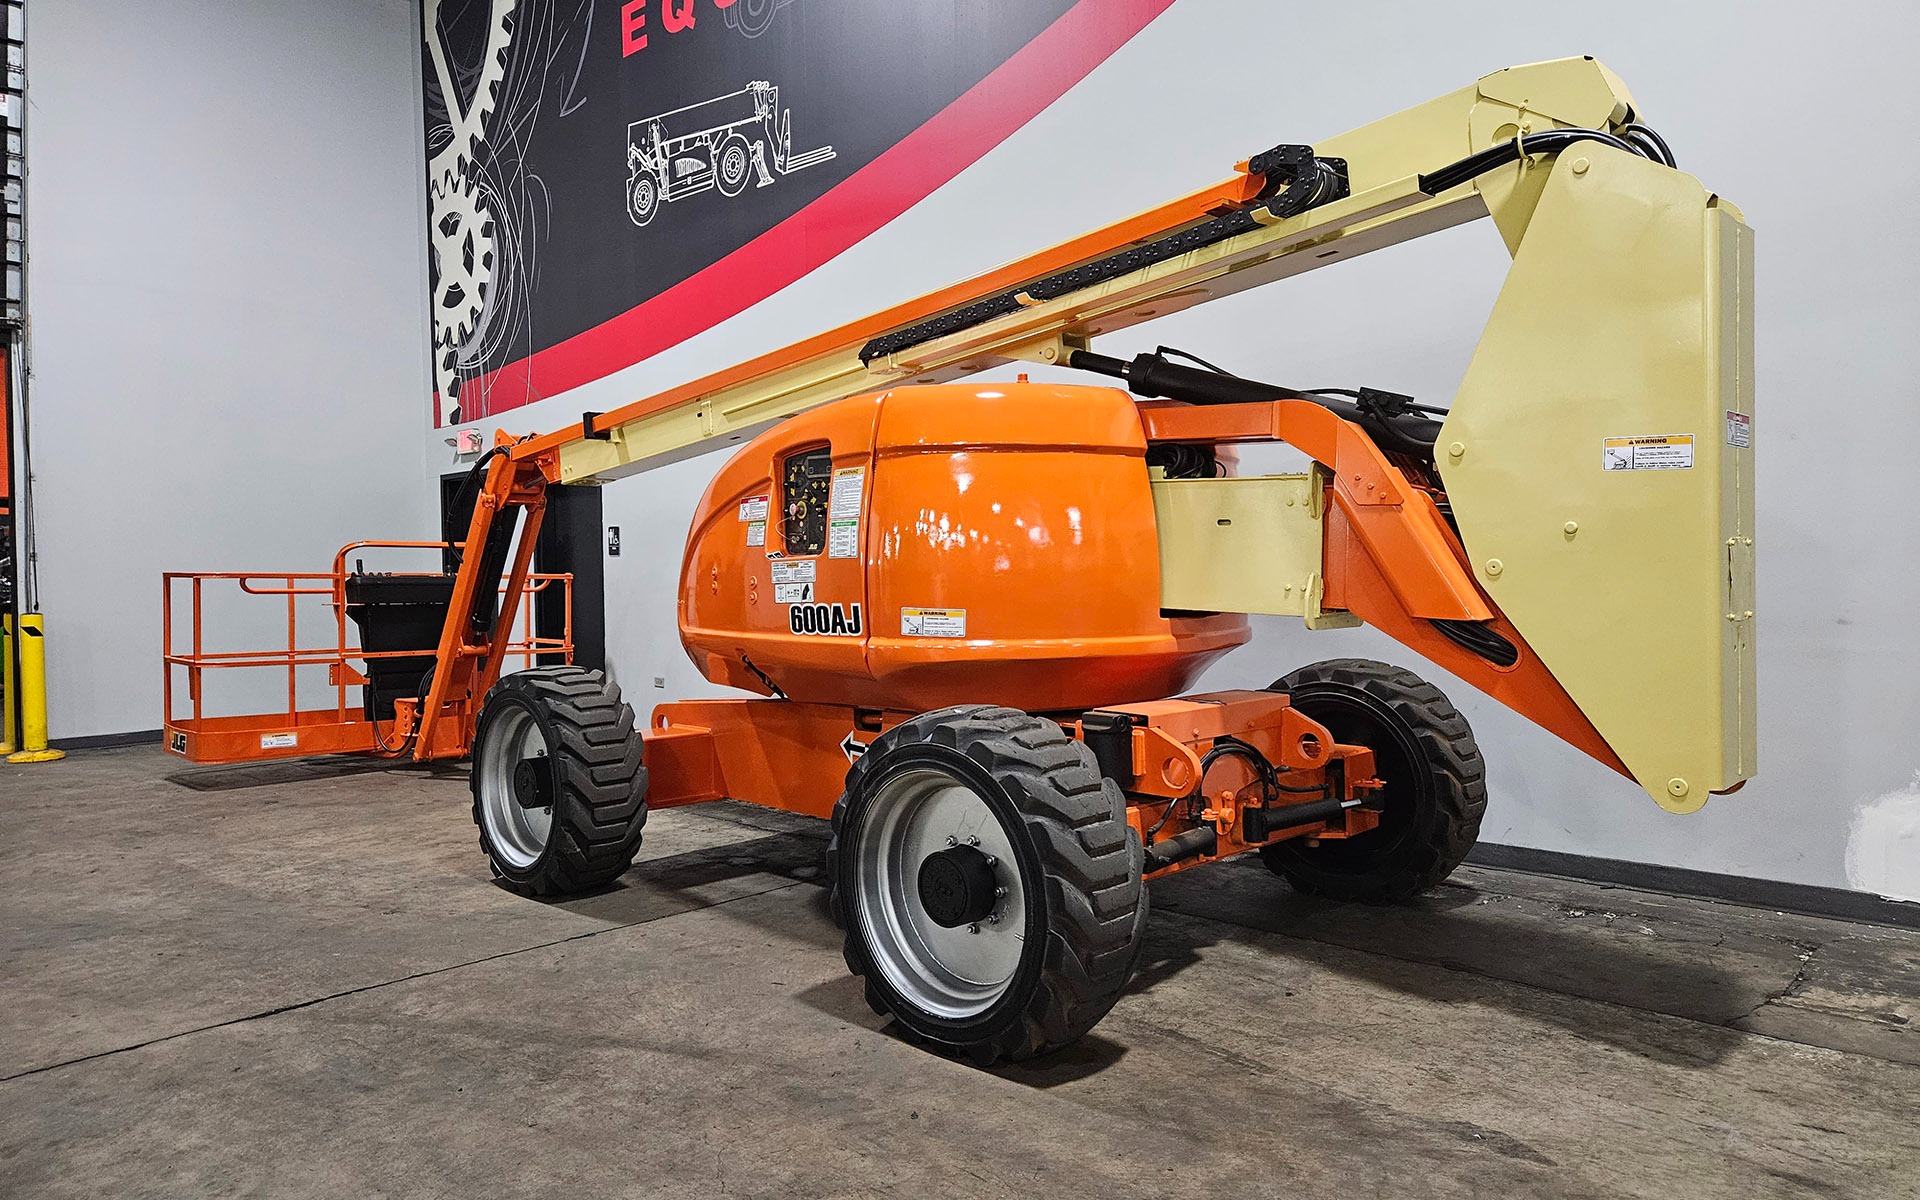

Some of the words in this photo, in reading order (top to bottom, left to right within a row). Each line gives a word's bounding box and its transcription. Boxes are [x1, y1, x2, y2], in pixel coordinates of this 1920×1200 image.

[621, 0, 738, 58] EQ
[789, 603, 862, 636] 600AJ
[171, 731, 187, 754] JLG
